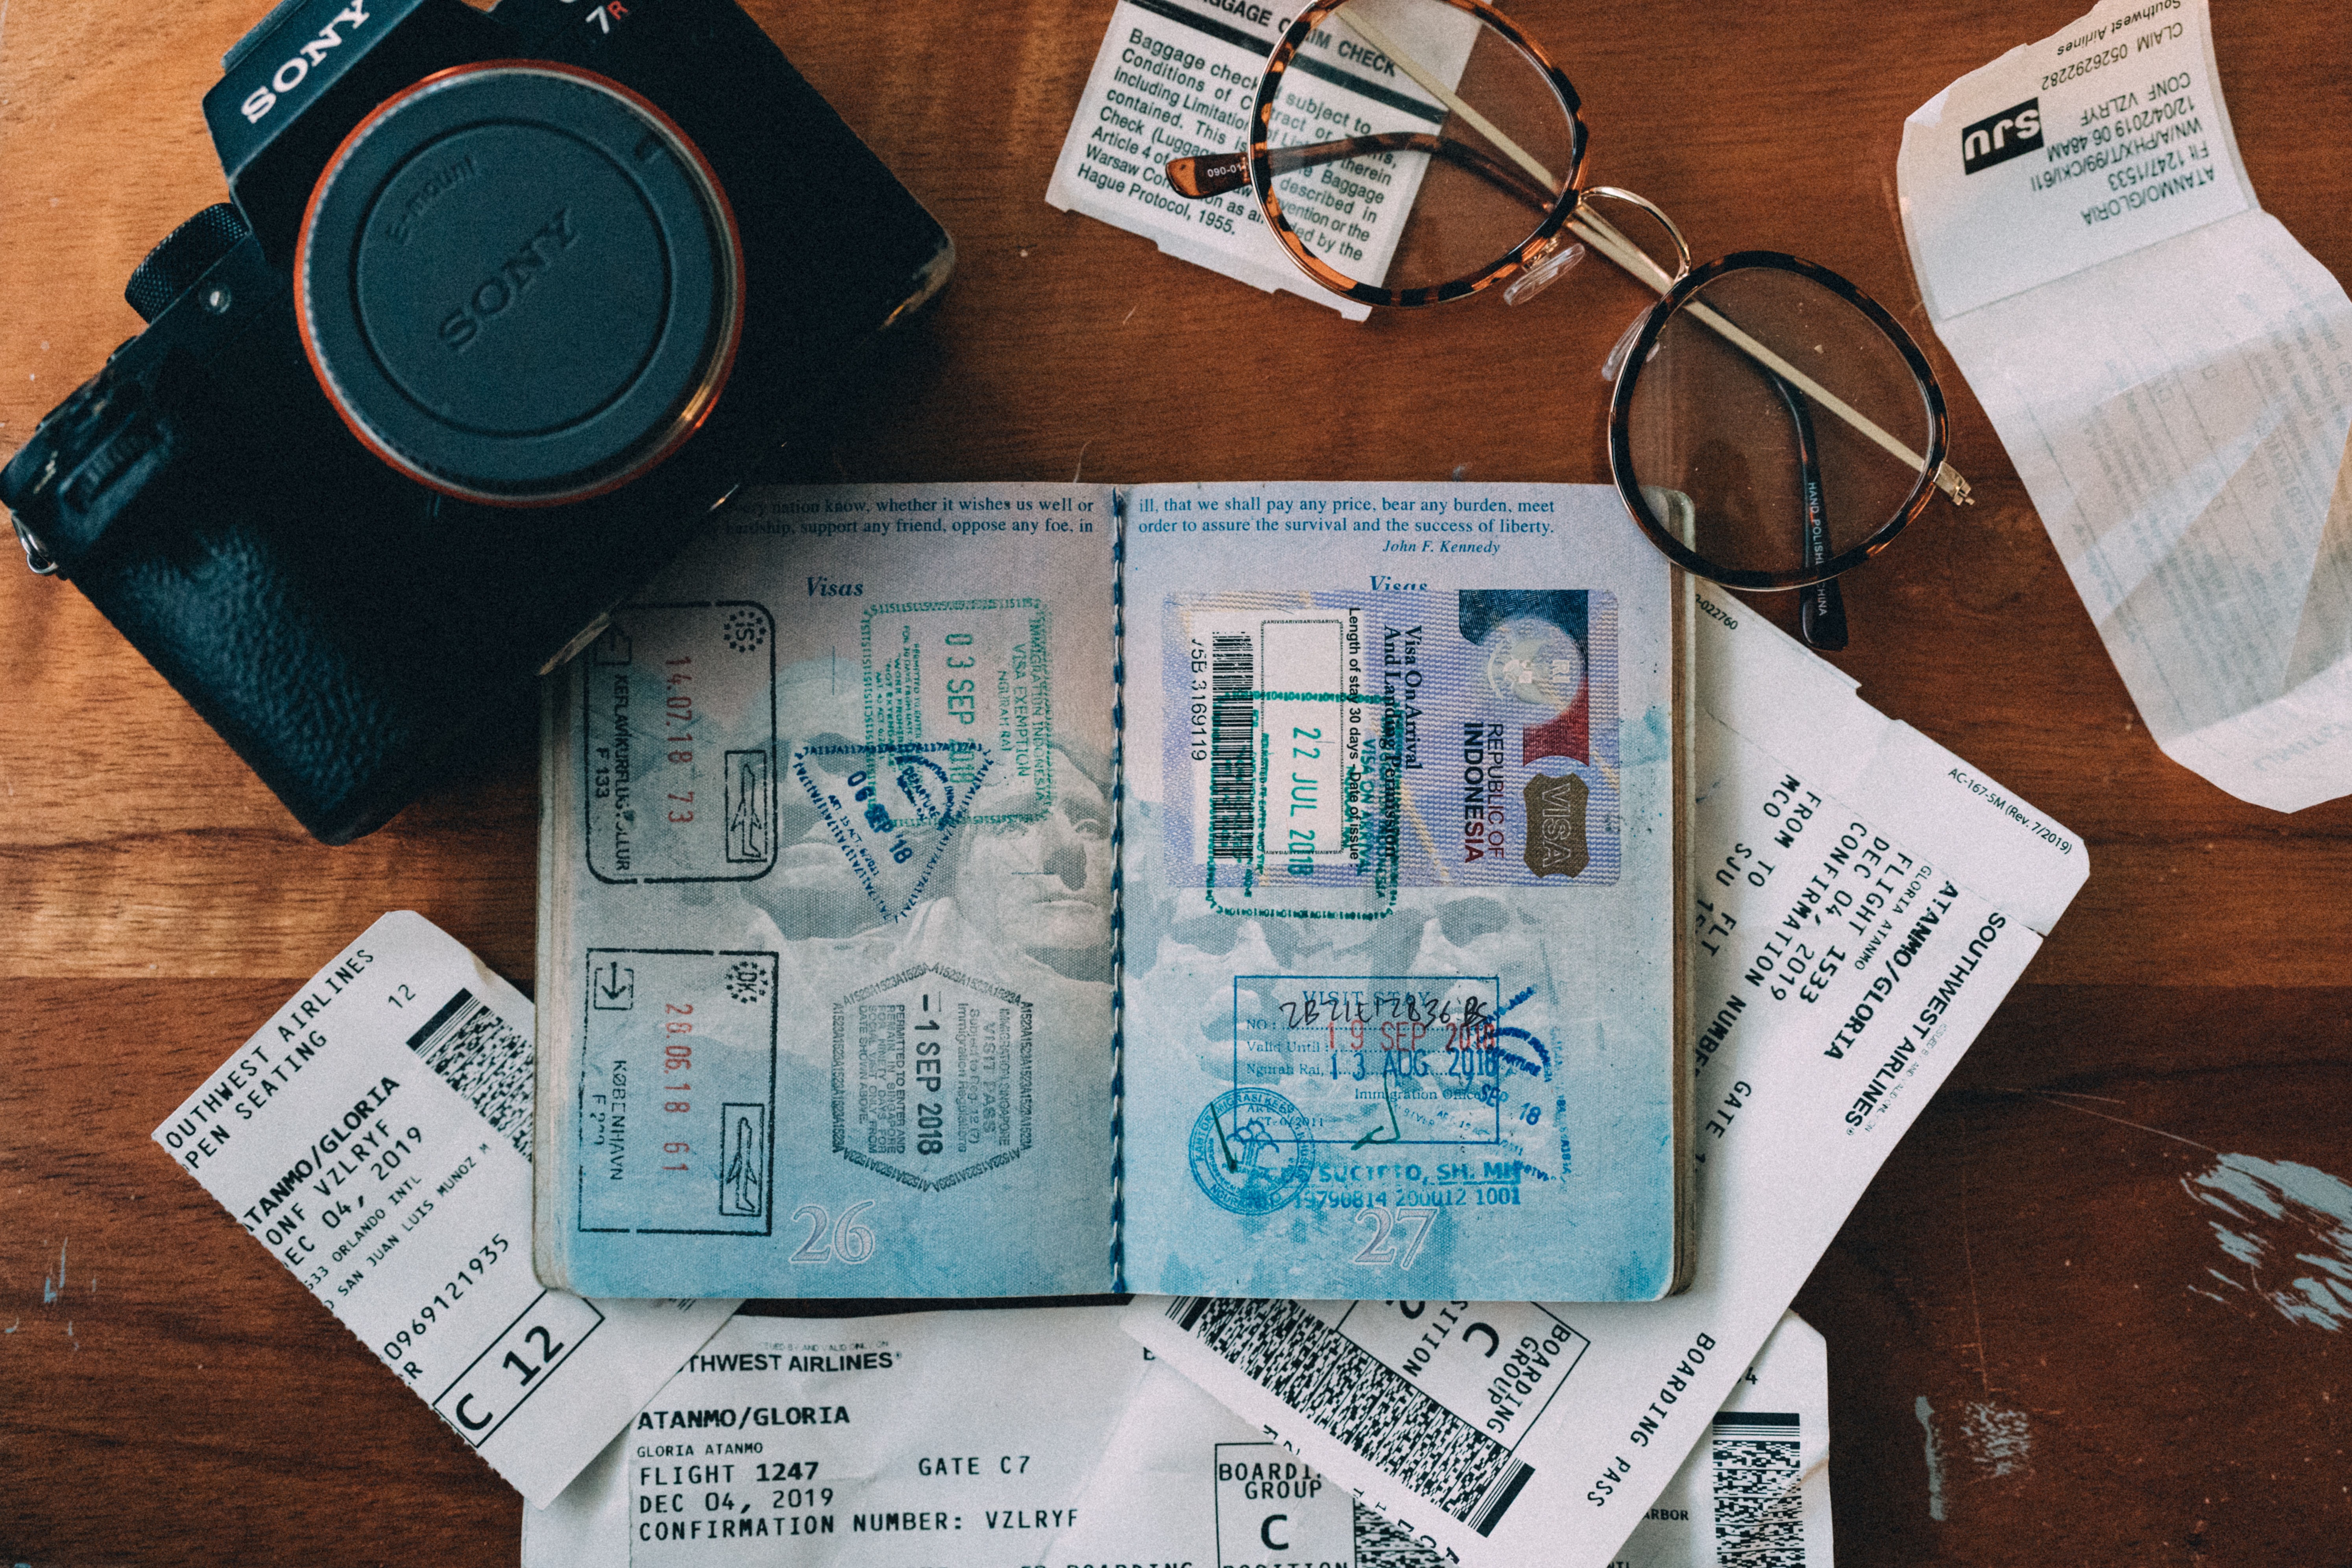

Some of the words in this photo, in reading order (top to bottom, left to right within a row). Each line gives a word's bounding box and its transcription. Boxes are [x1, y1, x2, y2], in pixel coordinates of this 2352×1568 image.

[1338, 39, 1396, 77] CHECK
[2057, 26, 2107, 56] Airlines
[2137, 22, 2183, 52] CLAIM
[242, 0, 369, 123] SONY
[1122, 48, 1205, 92] Conditions
[1129, 28, 1205, 70] Baggage
[1286, 94, 1350, 127] subject
[2042, 44, 2128, 91] 0526292282
[2081, 92, 2138, 127] VZLRYF
[2149, 72, 2191, 101] CONF
[1091, 126, 1139, 154] Article
[1114, 67, 1180, 107] including
[1341, 156, 1391, 185] therein
[1964, 109, 2041, 161] SJU
[2115, 96, 2195, 138] 12/04/2019
[1086, 144, 1140, 176] Warsaw
[1100, 106, 1144, 135] Check
[1280, 179, 1354, 214] described
[1107, 89, 1182, 129] contained.
[1196, 120, 1226, 145] This
[1321, 170, 1385, 204] Baggage
[2108, 151, 2184, 191] 1247/1533
[1077, 163, 1125, 193] Hague
[1128, 183, 1191, 220] Protocol,
[1199, 210, 1235, 235] 1955.
[2081, 166, 2214, 225] ATANMO/GLORIA
[438, 208, 579, 353] SONY
[800, 521, 857, 536] support
[896, 518, 946, 533] friend,
[952, 521, 1006, 535] oppose
[1045, 518, 1073, 532] foe,
[825, 498, 870, 514] know,
[876, 498, 937, 512] whether
[959, 497, 1011, 510] wishes
[1039, 498, 1072, 511] well
[1139, 519, 1177, 532] order
[1202, 521, 1250, 531] assure
[1285, 517, 1346, 531] survival
[1415, 522, 1473, 532] success
[1500, 519, 1554, 536] liberty.
[1140, 499, 1158, 513] ill,
[1164, 498, 1191, 511] that
[1225, 497, 1260, 510] shall
[1267, 501, 1293, 514] pay
[1333, 497, 1376, 514] price,
[1382, 497, 1415, 511] bear
[1454, 498, 1512, 513] burden,
[1518, 501, 1554, 513] meet
[1382, 540, 1416, 552] John
[1440, 540, 1500, 556] Kennedy
[806, 576, 863, 597] Visas
[1346, 607, 1361, 654] Length
[1383, 624, 1401, 668] And
[1404, 625, 1422, 665] Visa
[1011, 643, 1026, 681] VISA
[946, 679, 975, 725] SEP
[1346, 676, 1361, 704] stay
[1378, 670, 1401, 751] Landing
[1012, 687, 1030, 778] EXEMPTION
[1191, 680, 1207, 761] 3169119
[1347, 727, 1361, 759] days
[1404, 705, 1423, 769] Arrival
[595, 766, 609, 798] 133
[1290, 772, 1317, 817] JUL
[1348, 772, 1361, 802] Date
[1463, 722, 1484, 864] INDONESIA
[1486, 723, 1504, 826] REPUBLIC
[1763, 774, 1800, 818] MCO
[667, 790, 694, 824] 73
[1382, 755, 1400, 859] Permission
[1541, 784, 1572, 868] VISA
[1774, 791, 1822, 848] FROM
[1948, 768, 2006, 810] AC-167-5M
[2005, 805, 2029, 824] (Rev.
[2032, 822, 2072, 855] 7/2019)
[1348, 824, 1361, 860] issue
[1716, 843, 1752, 887] SJU
[1854, 837, 1890, 879] DEC
[1744, 822, 1867, 986] CONFIRMATION
[1815, 890, 1853, 925] 04,
[1849, 852, 1913, 936] FLIGHT
[1892, 866, 1931, 914] GLORIA
[1701, 912, 1737, 956] FLT
[1855, 920, 1892, 970] ATANMO
[1770, 943, 1814, 1001] 2019
[1800, 946, 1846, 1003] 1533
[1824, 881, 1958, 1059] ATANMO/GLORIA
[1912, 912, 2006, 1039] SOUTHWEST
[388, 984, 416, 1008] 12
[166, 1046, 268, 1148] OUTHWEST
[278, 949, 373, 1042] AIRLINES
[895, 1005, 905, 1067] PERMITTED
[1381, 1022, 1426, 1052] SEP
[915, 1041, 940, 1093] SEP
[1384, 1049, 1428, 1078] AUG
[181, 1125, 230, 1173] PEN
[235, 1031, 326, 1119] SEATING
[609, 1060, 627, 1180] KØBENHAVN
[1705, 1081, 1752, 1138] GATE
[916, 1103, 943, 1156] 2018
[313, 1119, 389, 1196] VZLRYF
[322, 1195, 364, 1228] 04,
[371, 1127, 421, 1181] 2019
[332, 1209, 385, 1262] ORLANDO
[388, 1177, 421, 1205] INTL
[1477, 1187, 1521, 1206] 1001
[338, 1271, 364, 1296] SAN
[367, 1235, 399, 1266] JUAN
[402, 1200, 434, 1231] LUIS
[437, 1156, 476, 1196] MUNOZ
[789, 1199, 876, 1265] 26
[1352, 1206, 1440, 1270] 27
[379, 1234, 508, 1366] 0969121935
[678, 1351, 782, 1373] THWEST
[1462, 1322, 1499, 1358] C
[456, 1393, 493, 1430] C
[503, 1326, 564, 1386] 12
[1487, 1336, 1539, 1404] GROUP
[1487, 1324, 1571, 1433] BOARDING
[1630, 1332, 1716, 1447] BOARDING
[637, 1406, 850, 1429] ATANMO/GLORIA
[637, 1445, 694, 1457] GLORIA
[706, 1442, 763, 1454] ATANMO
[641, 1465, 734, 1485] FLIGHT
[757, 1461, 818, 1481] 1247
[919, 1457, 979, 1476] GATE
[640, 1494, 683, 1513] DEC
[705, 1492, 750, 1514] 04,
[773, 1488, 833, 1509] 2019
[1245, 1481, 1322, 1500] GROUP
[1587, 1456, 1631, 1507] PASS
[640, 1515, 833, 1541] CONFIRMATION
[854, 1512, 961, 1531] NUMBER:
[986, 1509, 1077, 1529] VZLRYF
[1261, 1514, 1289, 1550] C
